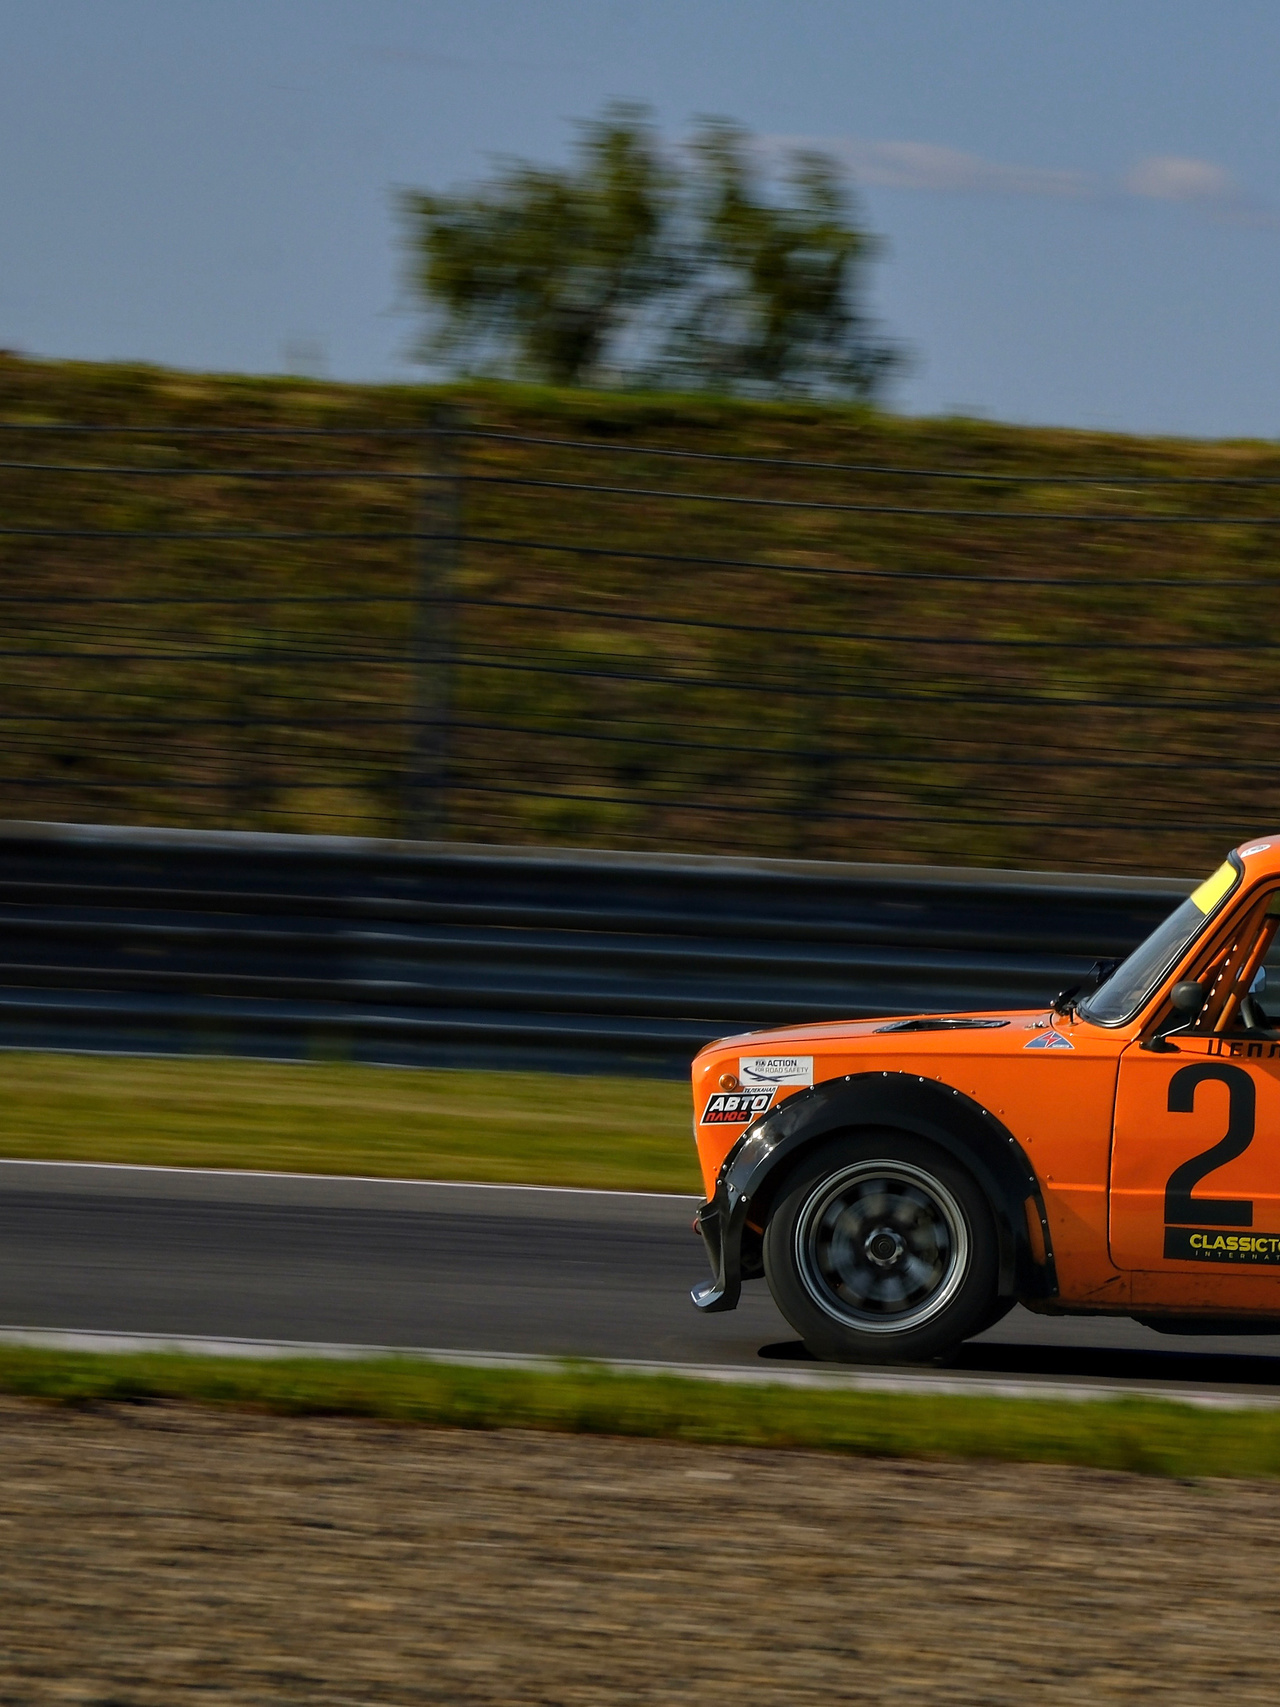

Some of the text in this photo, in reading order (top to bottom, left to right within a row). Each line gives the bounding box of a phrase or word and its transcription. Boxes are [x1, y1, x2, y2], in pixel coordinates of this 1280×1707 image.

[767, 1059, 797, 1067] ACTION
[709, 1095, 768, 1112] АВТО
[705, 1111, 748, 1122] ПЛЮС
